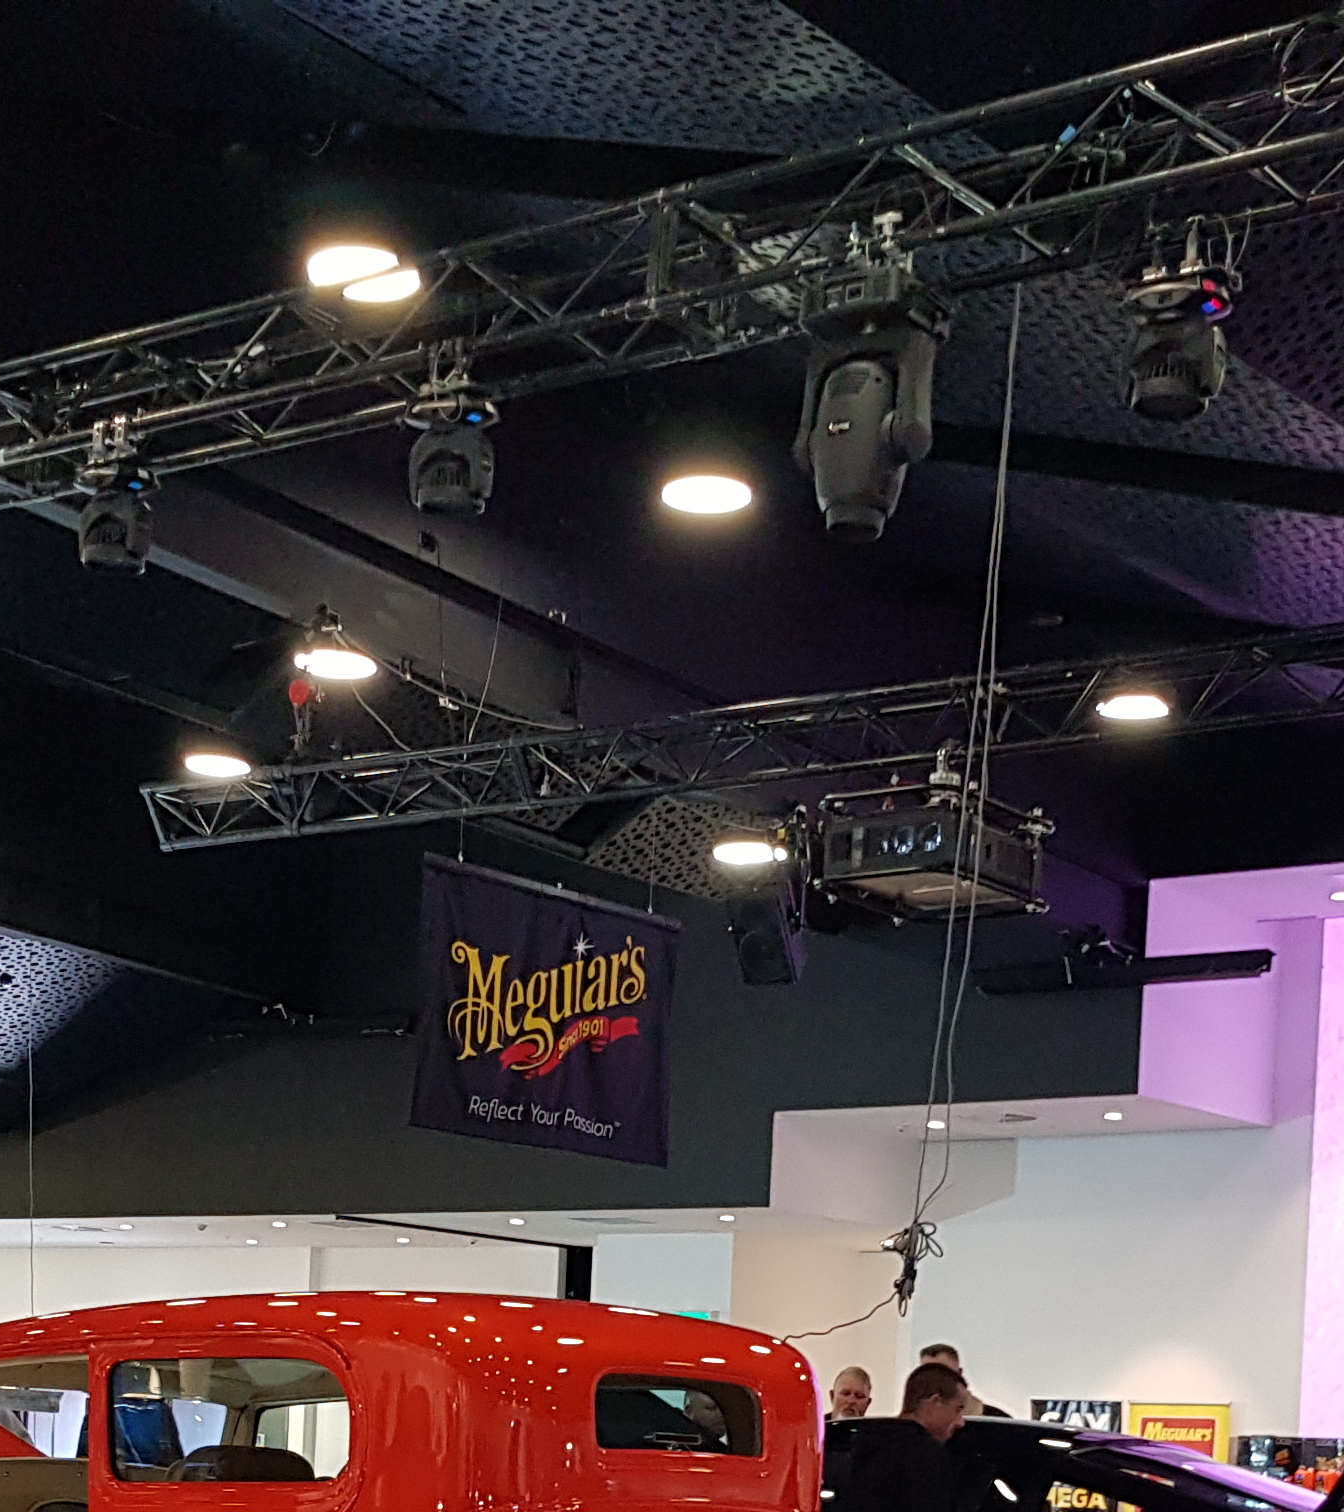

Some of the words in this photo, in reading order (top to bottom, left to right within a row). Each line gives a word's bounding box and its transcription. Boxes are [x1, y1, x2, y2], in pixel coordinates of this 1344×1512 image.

[448, 935, 646, 1071] Meguiar's
[468, 1095, 524, 1122] Reflect
[529, 1102, 561, 1127] Your
[1143, 1420, 1214, 1442] MEGUIAR'S
